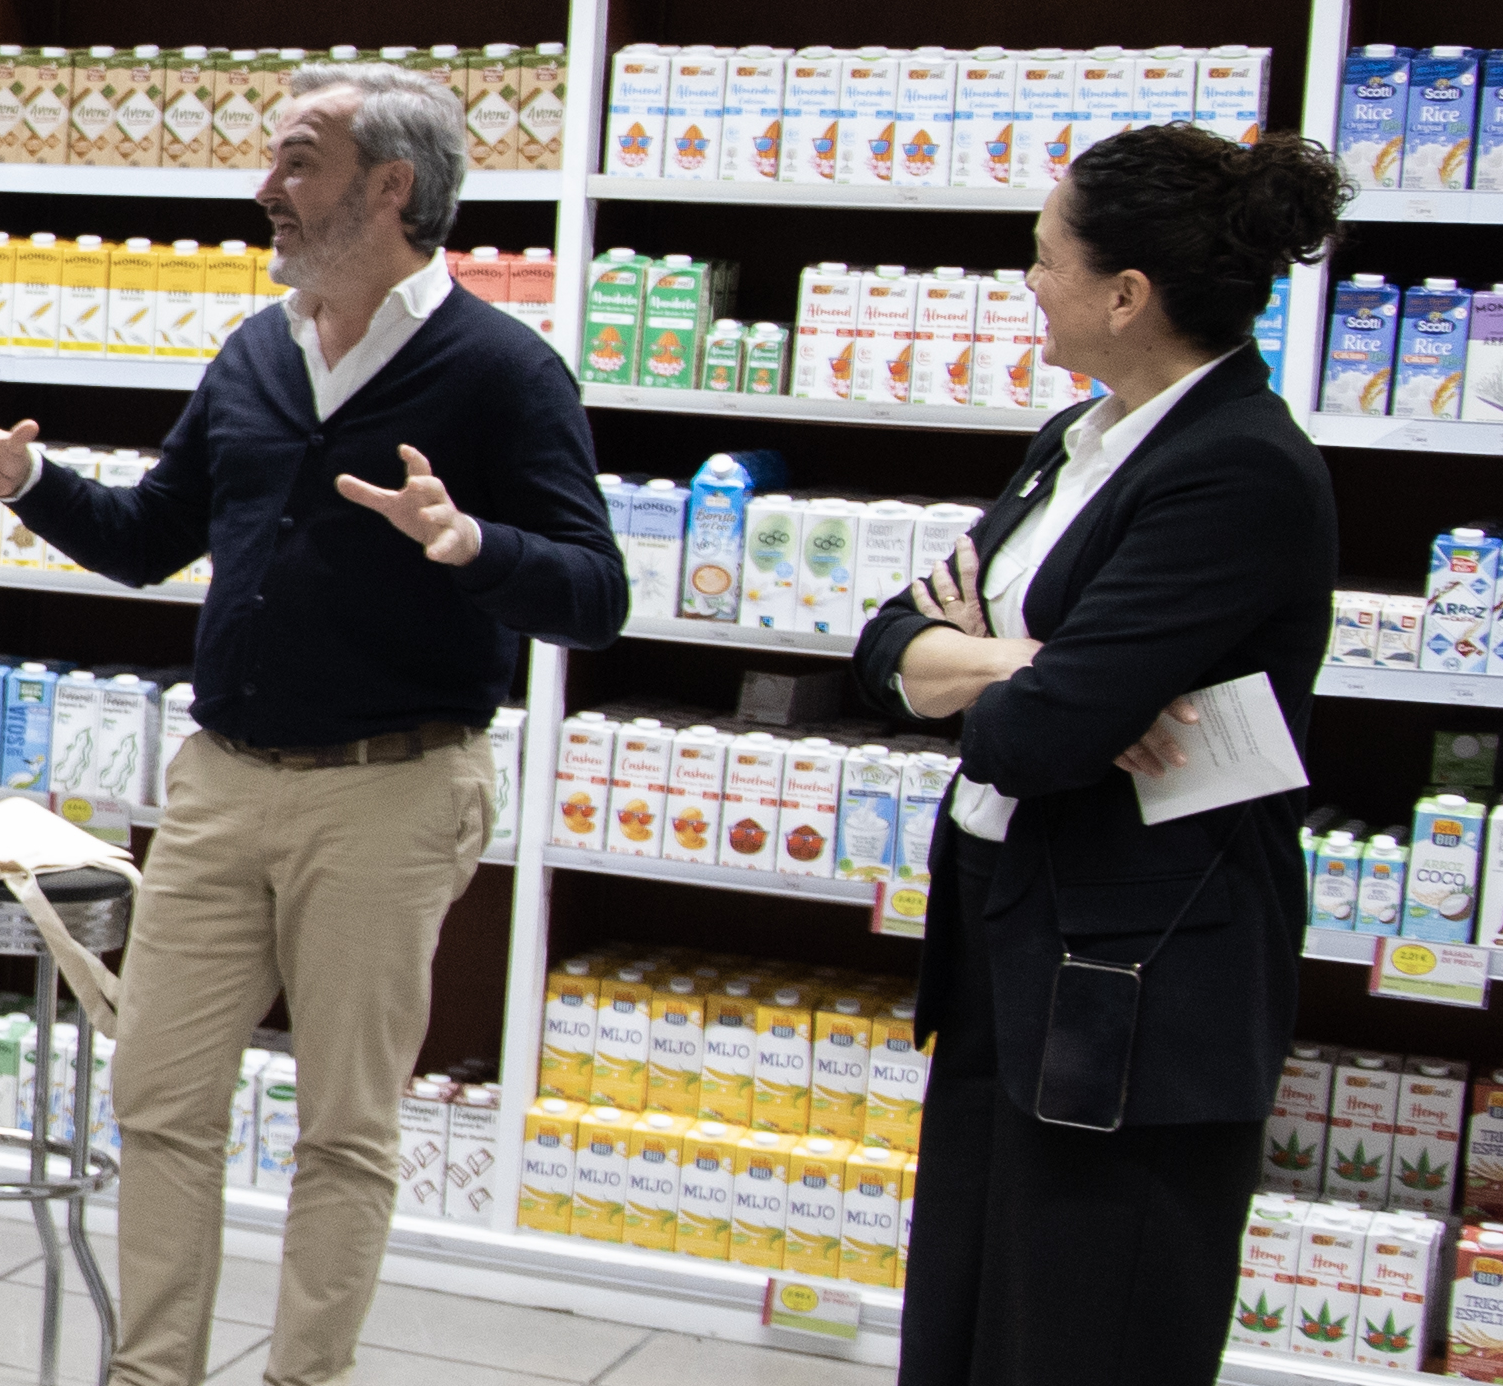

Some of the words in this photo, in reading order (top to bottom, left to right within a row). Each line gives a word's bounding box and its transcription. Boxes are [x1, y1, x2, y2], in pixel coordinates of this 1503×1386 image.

[1357, 85, 1393, 97] Scotti
[1424, 87, 1460, 100] Scotti
[31, 102, 62, 116] Avena
[78, 105, 110, 119] Avena
[123, 105, 155, 119] Avena
[171, 107, 205, 121] Avena
[221, 109, 254, 123] Avena
[475, 107, 510, 121] Avena
[528, 107, 563, 120] Avena
[1355, 104, 1393, 120] Rice
[1421, 106, 1460, 122] Rice
[18, 252, 58, 262] MONSOY
[64, 255, 104, 265] MONSOY
[112, 258, 153, 269] MONSOY
[160, 260, 201, 270] MONSOY
[208, 261, 250, 272] MONSOY
[807, 303, 852, 318] Almond
[864, 305, 909, 320] Almond
[923, 307, 968, 322] Almond
[983, 309, 1029, 324] Almond
[1345, 317, 1382, 329] Scotti
[1417, 321, 1453, 332] Scotti
[1343, 335, 1382, 352] Rice
[1415, 338, 1453, 355] Rice
[634, 501, 679, 514] MONSOY
[1431, 602, 1488, 619] ARROZ
[1417, 869, 1466, 886] COCO
[548, 1019, 590, 1037] MIJO
[601, 1026, 643, 1044] MIJO
[654, 1037, 696, 1056] MIJO
[707, 1041, 749, 1059] MIJO
[759, 1051, 804, 1070] MIJO
[818, 1059, 863, 1078] MIJO
[873, 1065, 919, 1084] MIJO
[1282, 1084, 1316, 1102] Hemp
[1346, 1095, 1383, 1113] Hemp
[1411, 1103, 1448, 1121] Hemp
[525, 1159, 568, 1179] MIJO
[579, 1167, 621, 1186] MIJO
[631, 1175, 673, 1194] MIJO
[684, 1183, 726, 1203] MIJO
[736, 1192, 780, 1211] MIJO
[791, 1201, 835, 1220] MIJO
[847, 1209, 891, 1229] MIJO
[1250, 1245, 1286, 1264] Hemp
[1313, 1254, 1348, 1273] Hemp
[1377, 1264, 1413, 1286] Hemp
